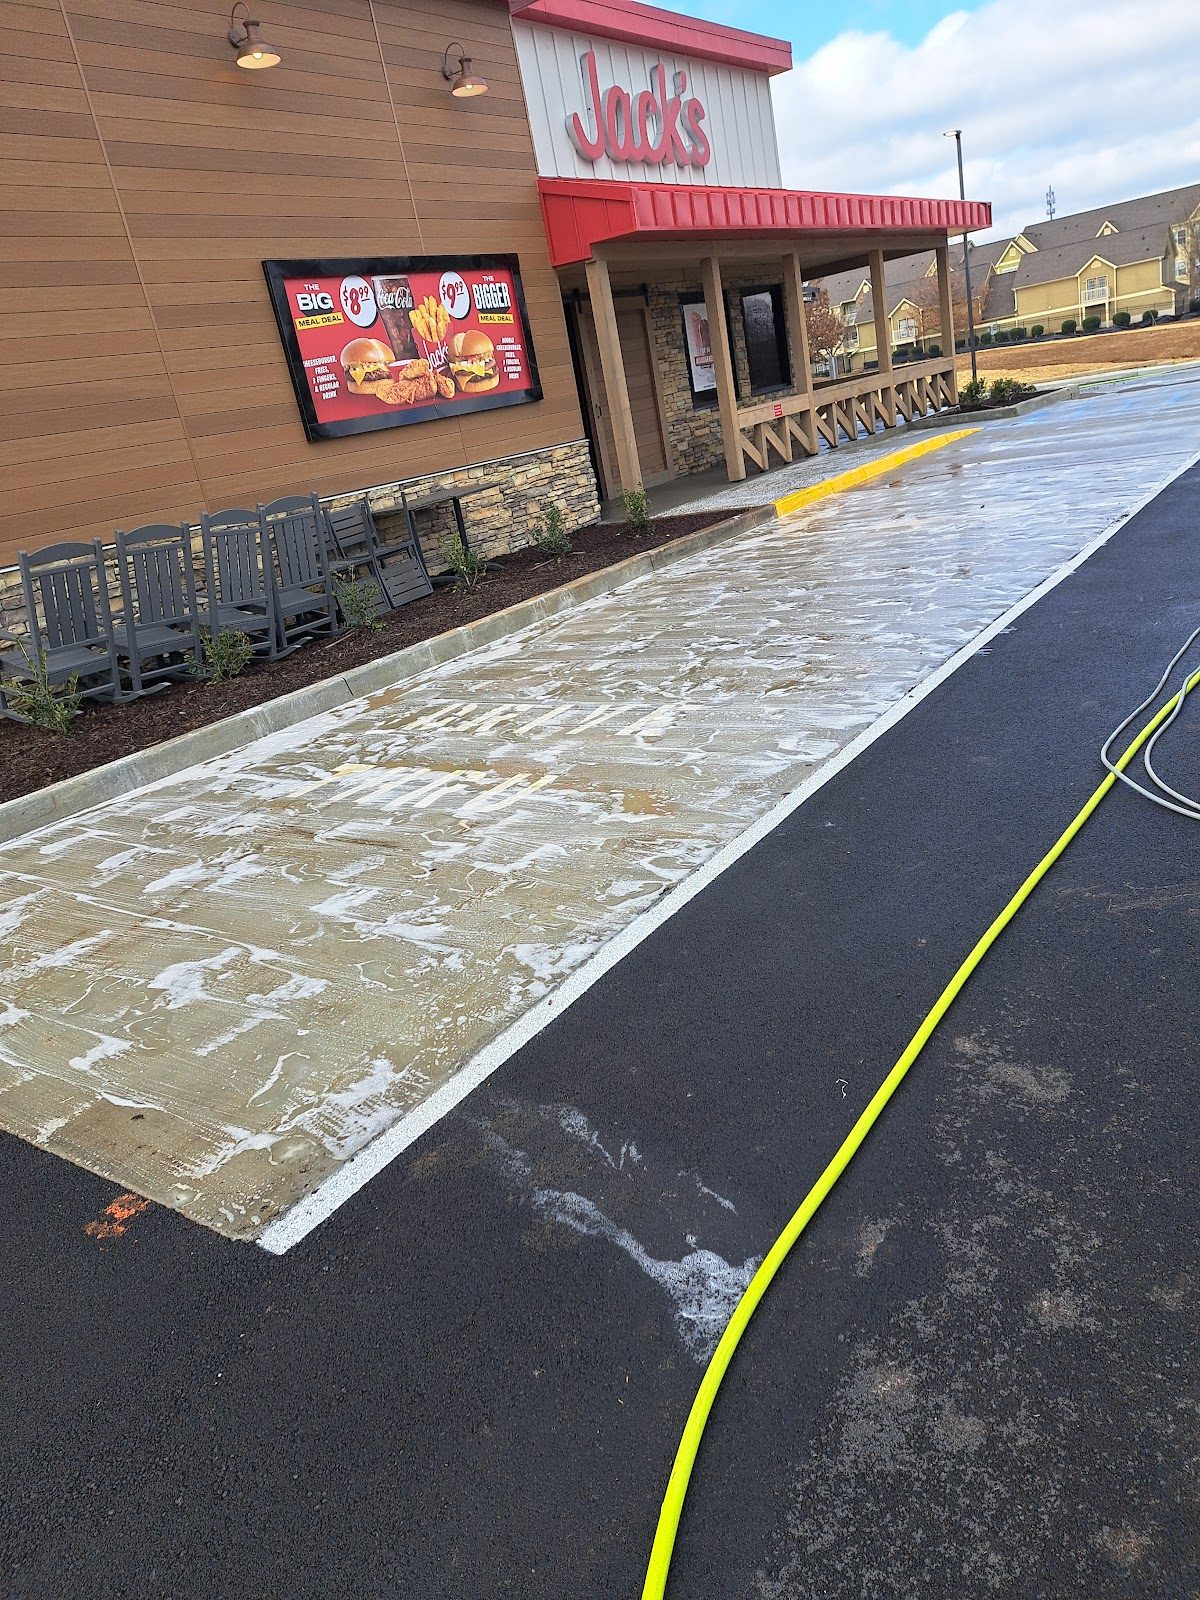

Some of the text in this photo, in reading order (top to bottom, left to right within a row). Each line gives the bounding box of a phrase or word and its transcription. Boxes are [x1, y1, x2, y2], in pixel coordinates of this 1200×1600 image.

[565, 49, 710, 168] Jack's
[304, 283, 320, 291] THE
[472, 283, 511, 309] BIGGER
[296, 293, 334, 311] BIG
[298, 315, 342, 327] MEAL DEAL
